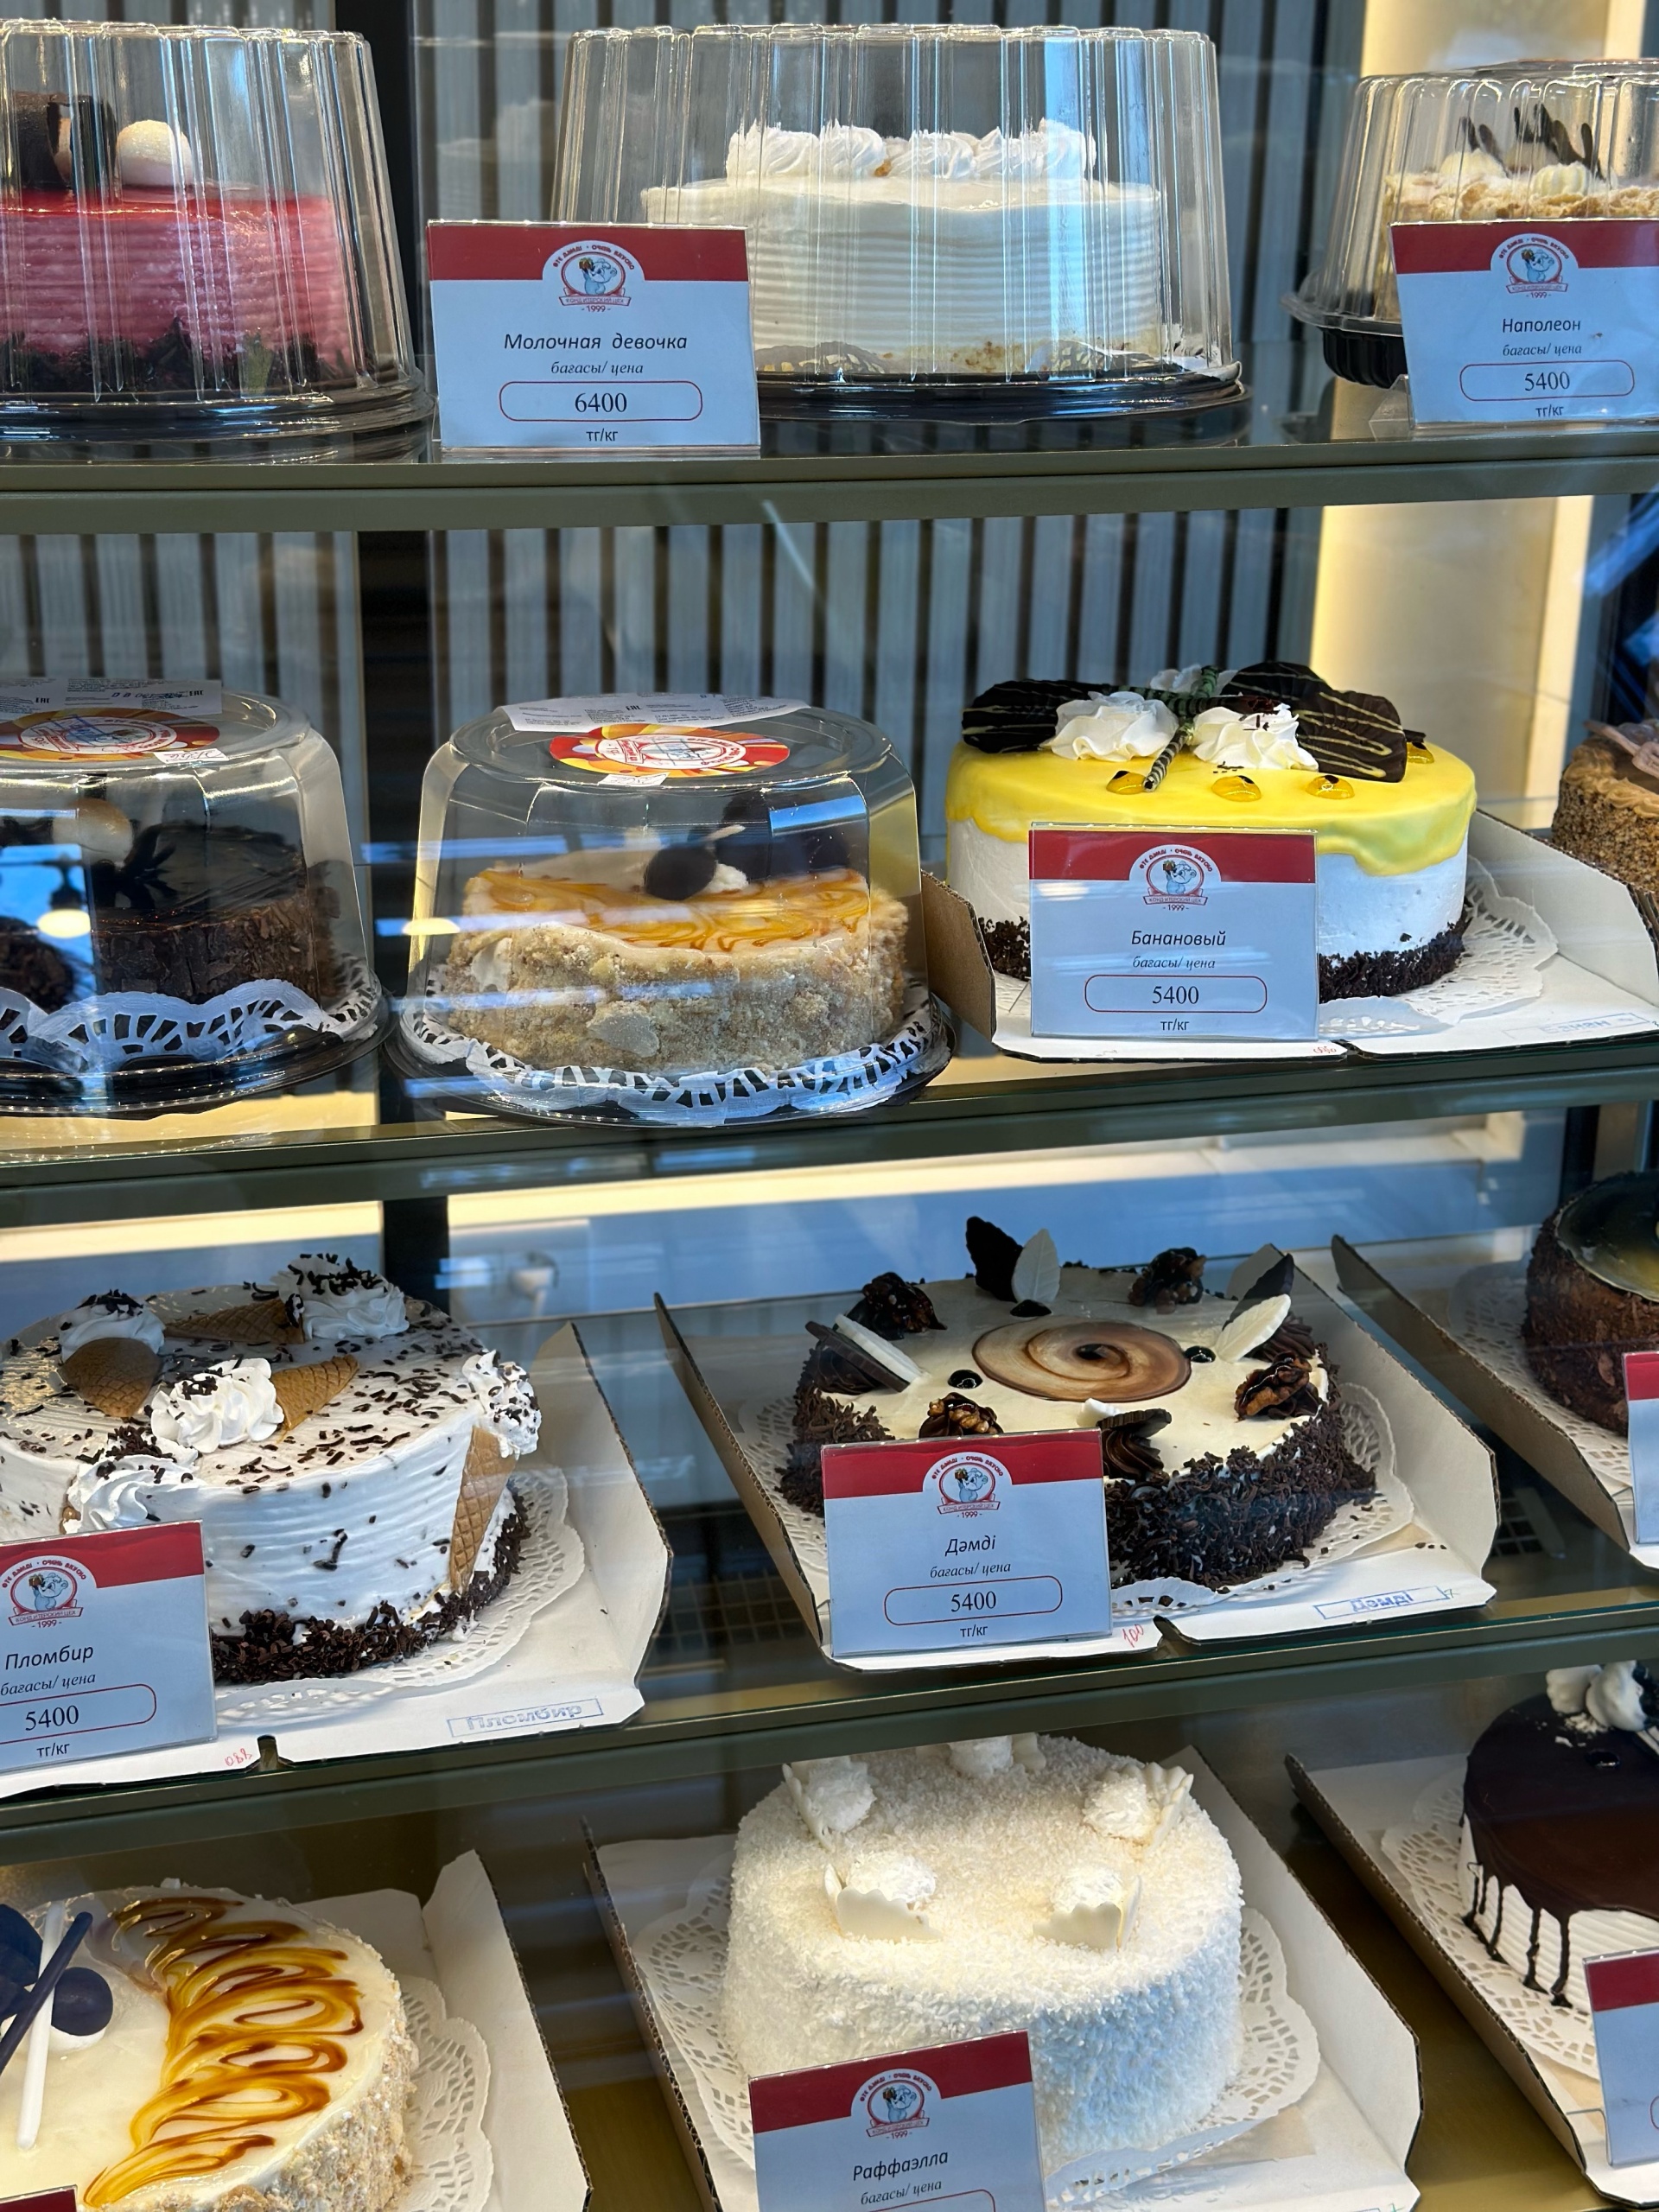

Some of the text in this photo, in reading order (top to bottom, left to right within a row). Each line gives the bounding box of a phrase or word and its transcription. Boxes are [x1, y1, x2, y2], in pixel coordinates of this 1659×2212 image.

[1502, 318, 1581, 333] Наполеон
[504, 334, 688, 351] Молочная девочка
[1554, 346, 1582, 357] цена
[611, 363, 644, 376] цена
[1524, 372, 1571, 391] 5400
[575, 392, 627, 414] 6400
[1535, 405, 1564, 417] тг/кг
[586, 429, 619, 442] тг/кг
[1131, 931, 1226, 946] Банановый
[1185, 958, 1216, 970] цена
[1152, 986, 1199, 1005] 5400
[1160, 1018, 1190, 1031] тг/кг
[944, 1535, 996, 1556] Дәмді
[982, 1562, 1012, 1576] цена
[950, 1591, 997, 1612] 5400
[38, 1619, 57, 1628] 1999
[960, 1625, 988, 1638] тг/кг
[5, 1645, 94, 1670] Пломбир
[62, 1674, 96, 1689] цена
[25, 1705, 79, 1732] 5400
[467, 1706, 582, 1730] Пломбир
[36, 1743, 70, 1758] тг/кг
[891, 2131, 908, 2139] 1999
[853, 2151, 949, 2182] Раффаэлла
[912, 2181, 942, 2196] цена
